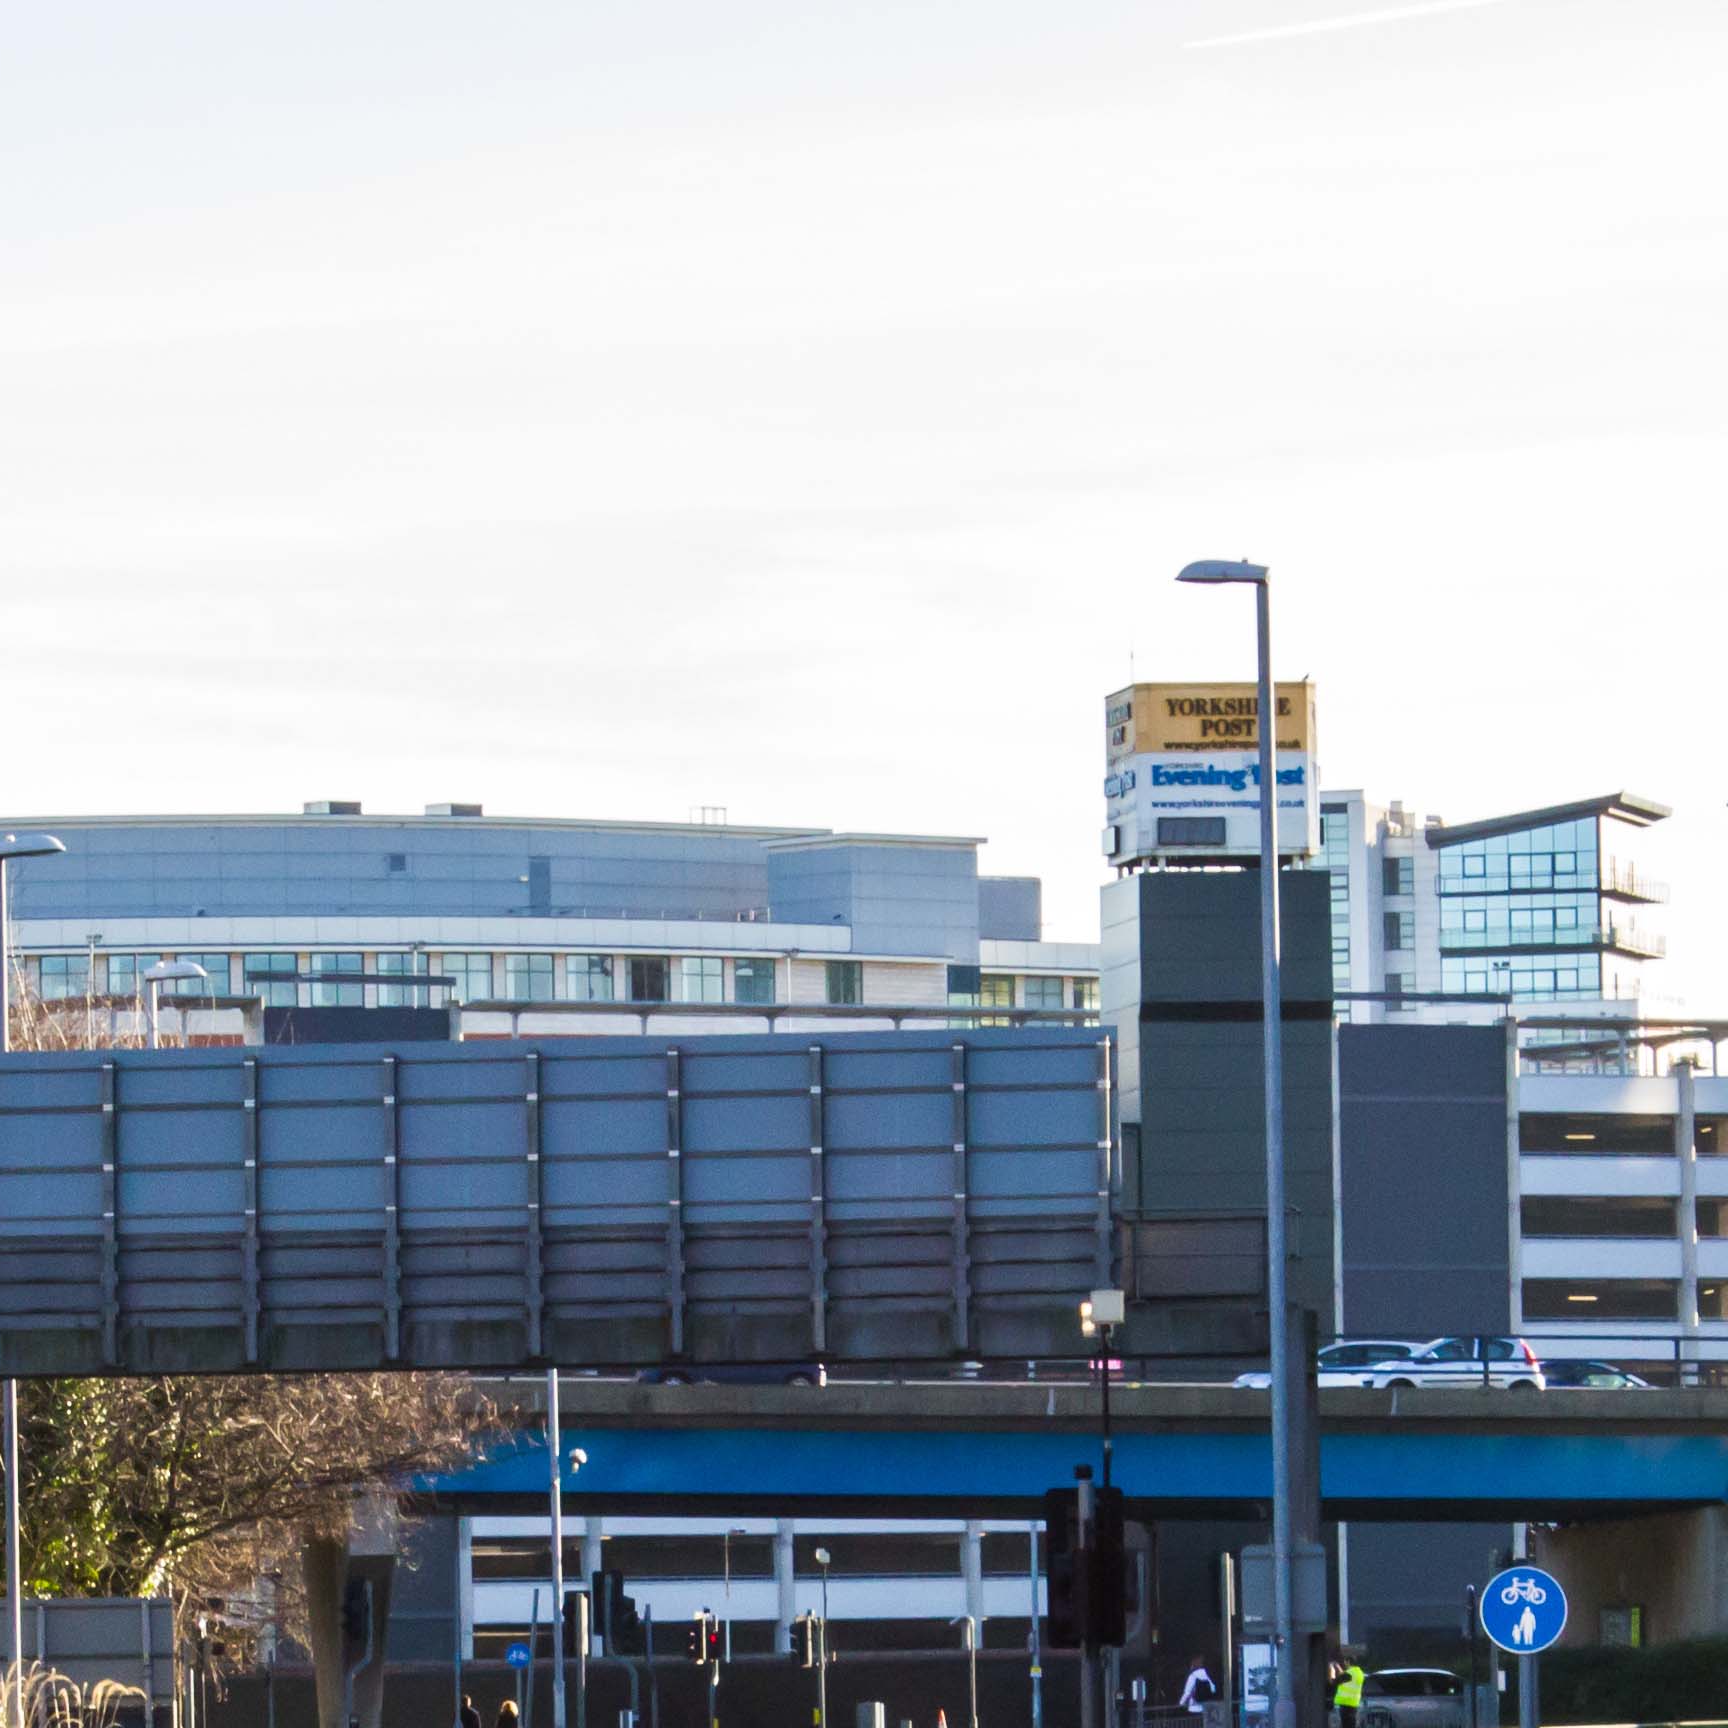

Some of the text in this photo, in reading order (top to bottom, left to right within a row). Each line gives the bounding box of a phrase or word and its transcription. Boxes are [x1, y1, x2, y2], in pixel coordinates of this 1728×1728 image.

[1166, 697, 1290, 717] YORKSHIE
[1200, 718, 1256, 737] POST
[1152, 763, 1247, 791] Evening
